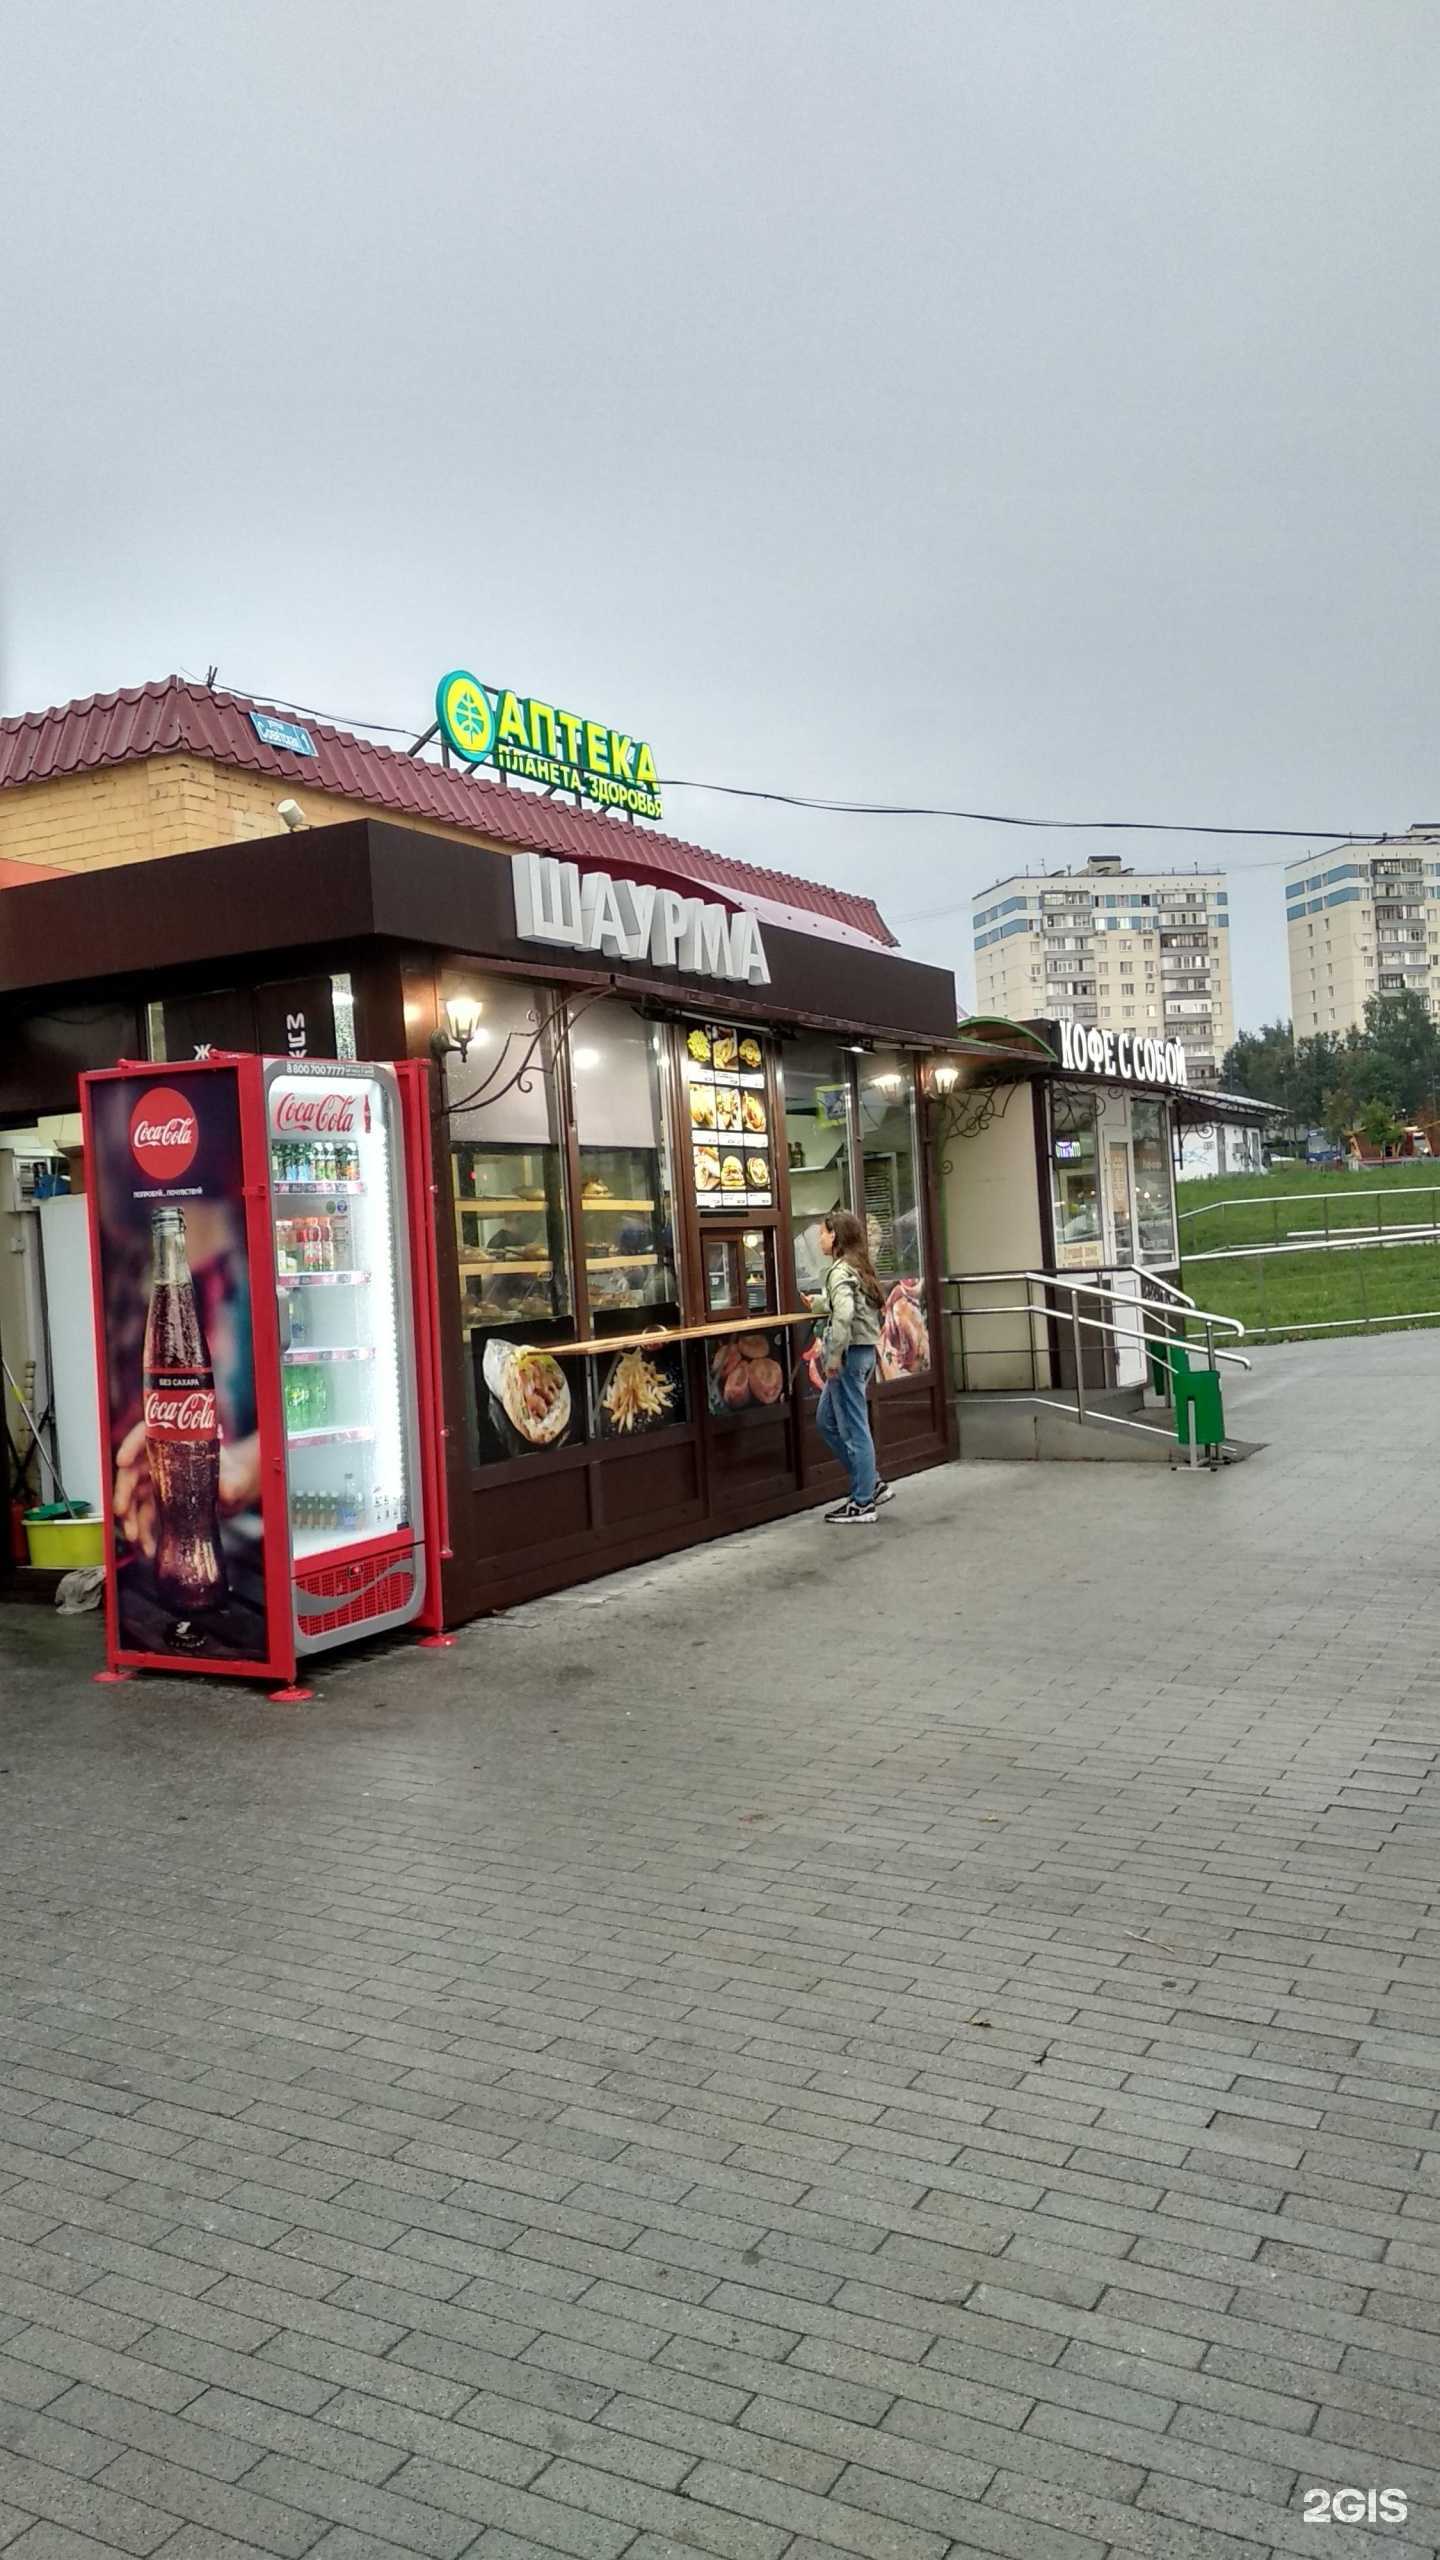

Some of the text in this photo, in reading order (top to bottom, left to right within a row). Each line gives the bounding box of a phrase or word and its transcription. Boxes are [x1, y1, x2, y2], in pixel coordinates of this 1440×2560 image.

[499, 690, 661, 793] АПТЕКА
[498, 744, 663, 818] ПЛАНЕТА ЗДОРОВЬЯ
[511, 852, 771, 986] ШАУРМА
[293, 1064, 310, 1075] 800
[310, 1064, 326, 1075] 700
[1059, 1020, 1188, 1086] КОФЕ С СОБОЙ
[134, 1118, 195, 1148] Coca-Cola
[276, 1092, 355, 1134] Coca-Cola
[159, 1378, 200, 1386] БЕЗ САХАРА
[145, 1393, 215, 1430] Coca-Cola
